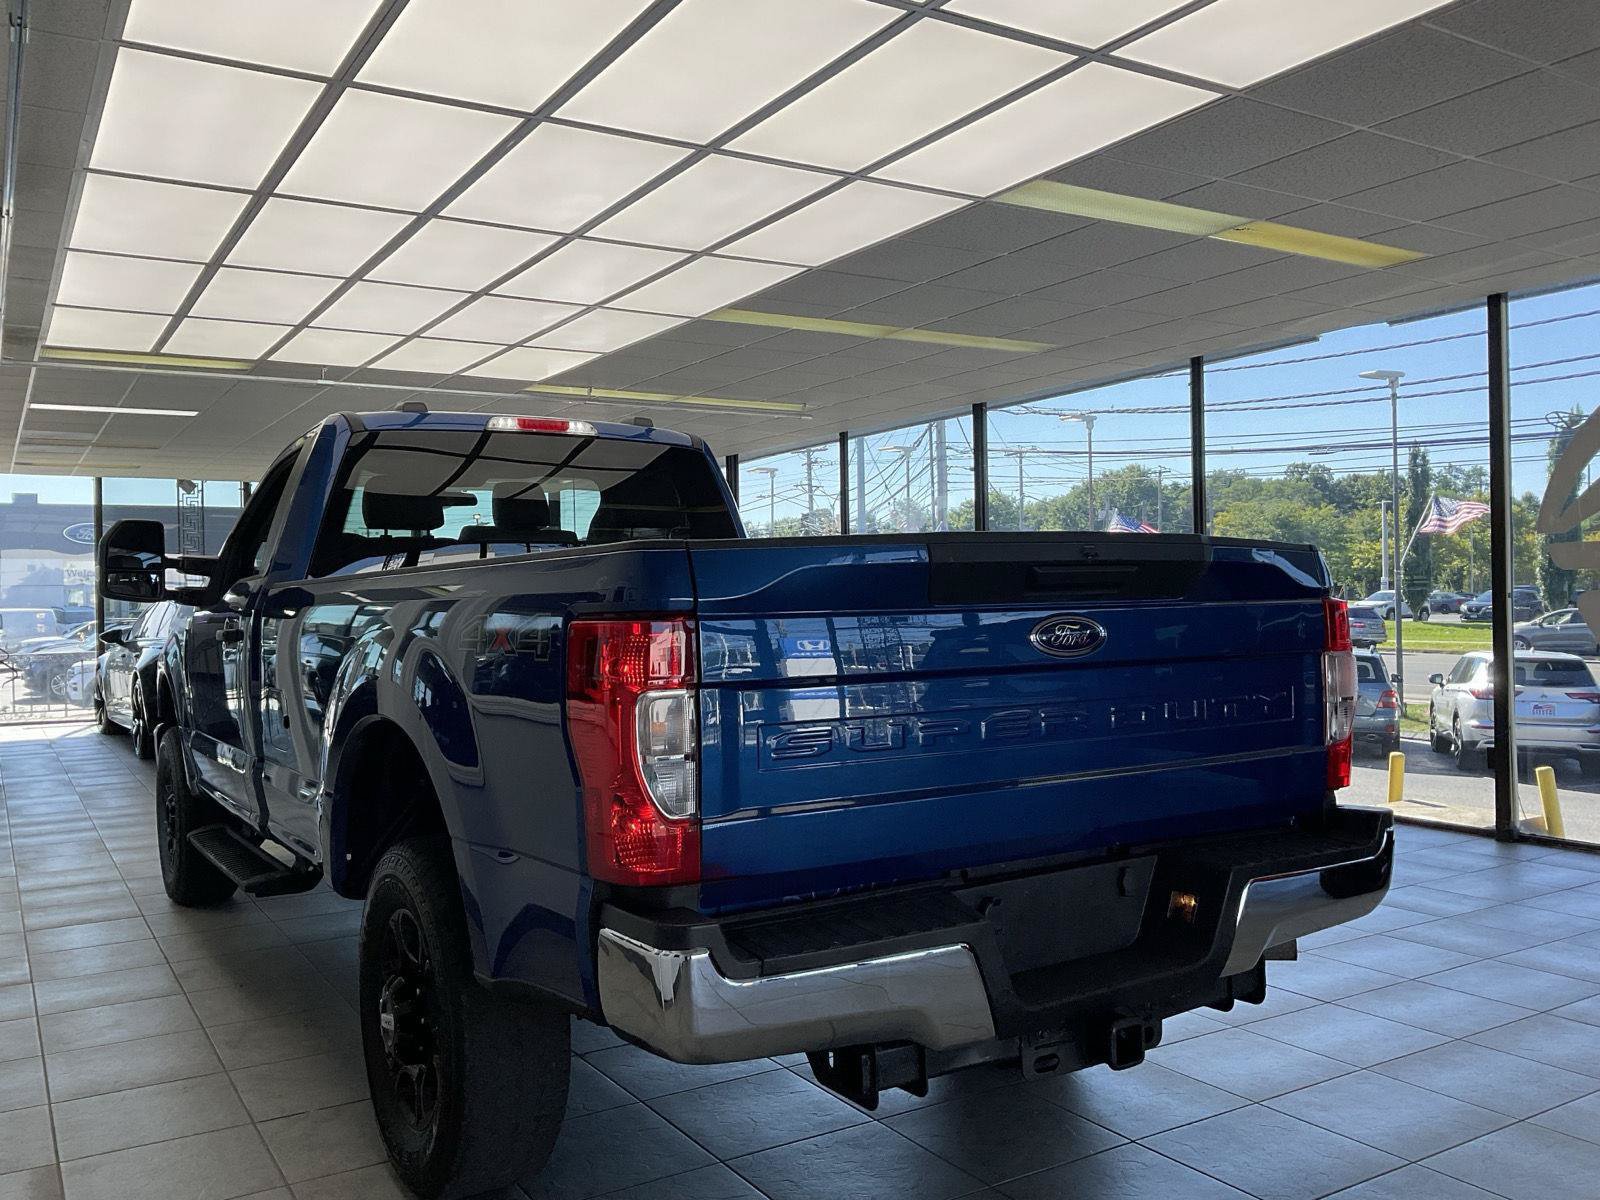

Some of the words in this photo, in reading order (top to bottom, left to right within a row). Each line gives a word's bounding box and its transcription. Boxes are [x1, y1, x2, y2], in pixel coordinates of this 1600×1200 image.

[1043, 624, 1091, 646] Ford
[766, 706, 1092, 762] SUPER
[1109, 690, 1289, 729] DUTY
